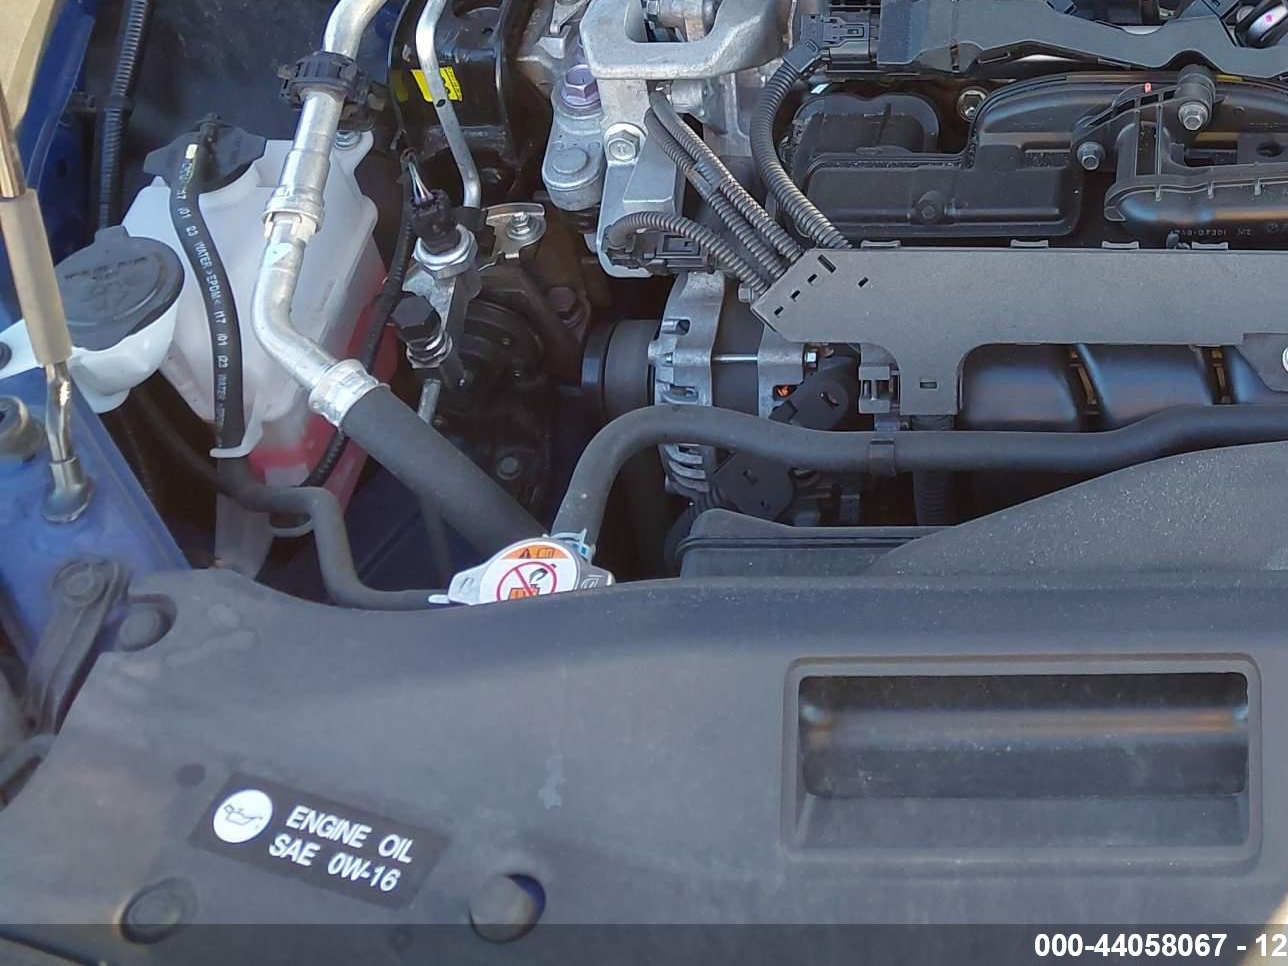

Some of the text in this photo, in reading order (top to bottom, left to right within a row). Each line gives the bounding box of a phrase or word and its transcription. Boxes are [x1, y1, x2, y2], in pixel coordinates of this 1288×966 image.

[194, 242, 213, 269] WATER
[269, 833, 401, 892] SAE 0W-16
[286, 805, 414, 864] ENGINE OIL
